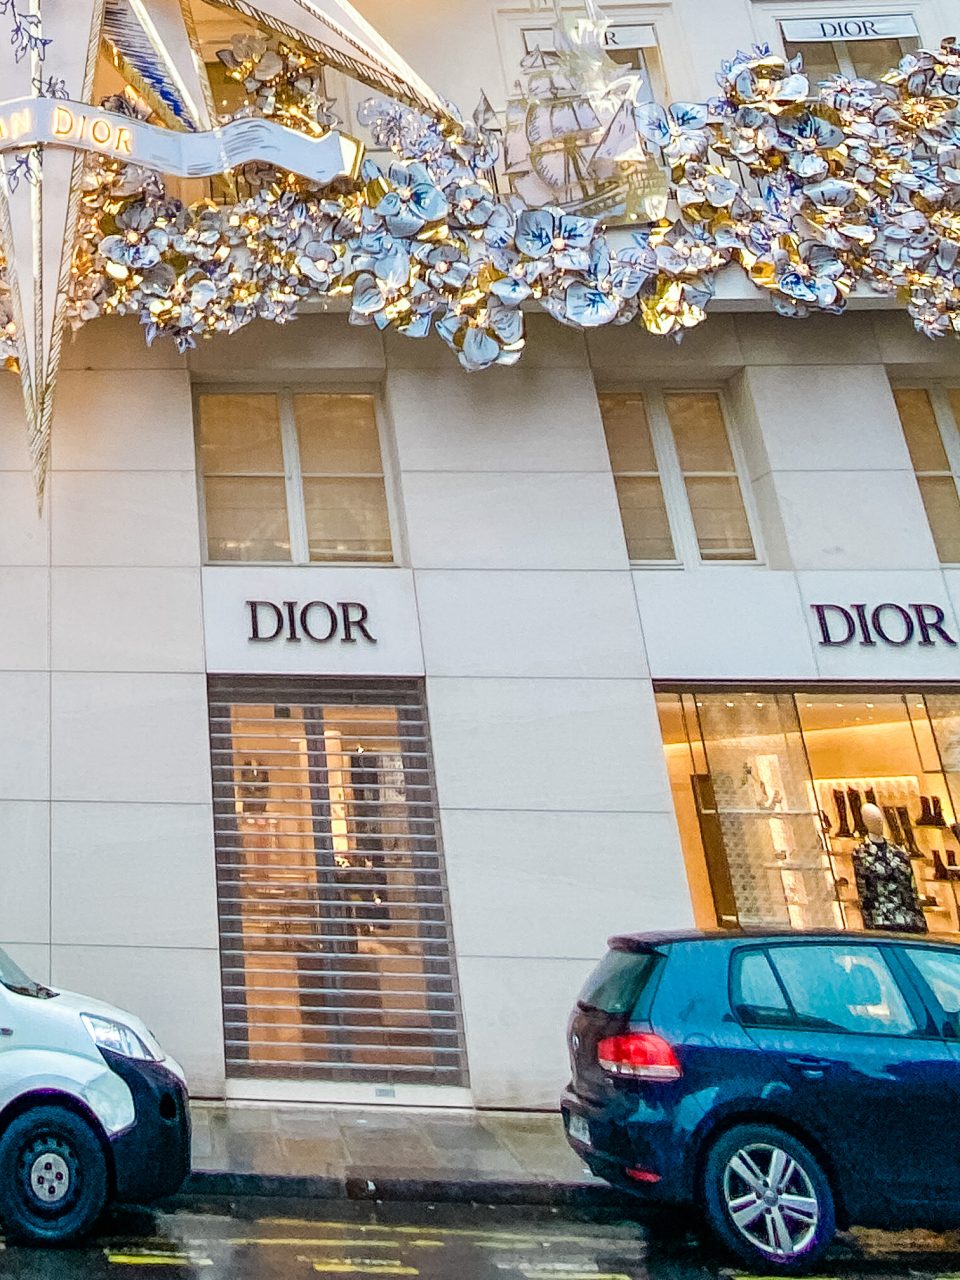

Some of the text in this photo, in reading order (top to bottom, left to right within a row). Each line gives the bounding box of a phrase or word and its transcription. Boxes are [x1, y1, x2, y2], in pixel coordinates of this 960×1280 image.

[819, 20, 881, 37] DIOR
[52, 106, 132, 155] DIOR
[246, 600, 377, 643] DIOR
[810, 602, 957, 647] DIOR
